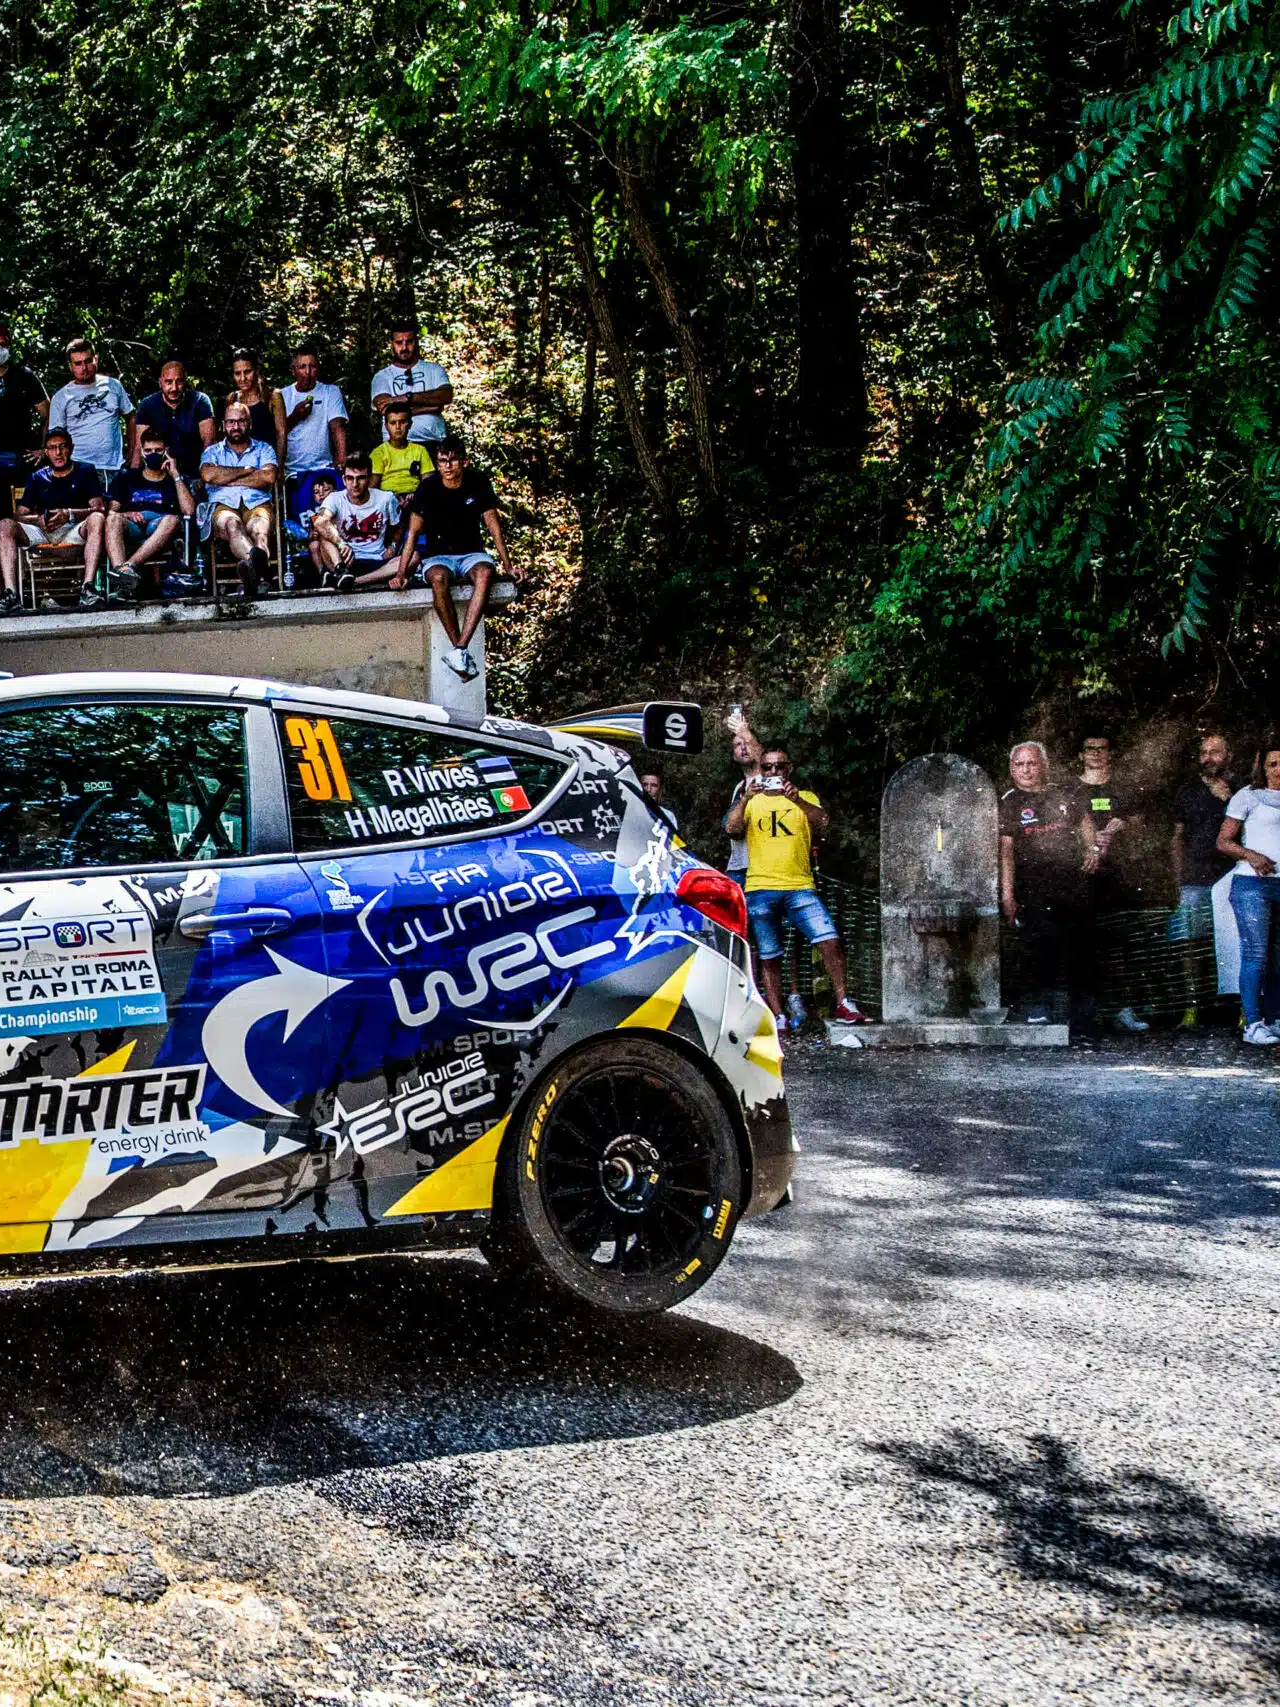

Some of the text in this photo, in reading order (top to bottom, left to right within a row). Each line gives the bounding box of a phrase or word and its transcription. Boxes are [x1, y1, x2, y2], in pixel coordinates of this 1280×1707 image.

[285, 718, 353, 801] 31
[381, 764, 480, 797] R Virves
[343, 794, 495, 839] H Magalhães
[430, 863, 489, 892] FIA
[387, 871, 572, 955] JUNIOR
[2, 966, 65, 984] RALLY
[71, 964, 91, 977] DI
[94, 959, 152, 975] ROMA
[389, 905, 617, 1027] WRC
[5, 974, 156, 1002] CAPITALE
[389, 1051, 485, 1103] JUNIOR
[98, 1126, 208, 1155] energy drink
